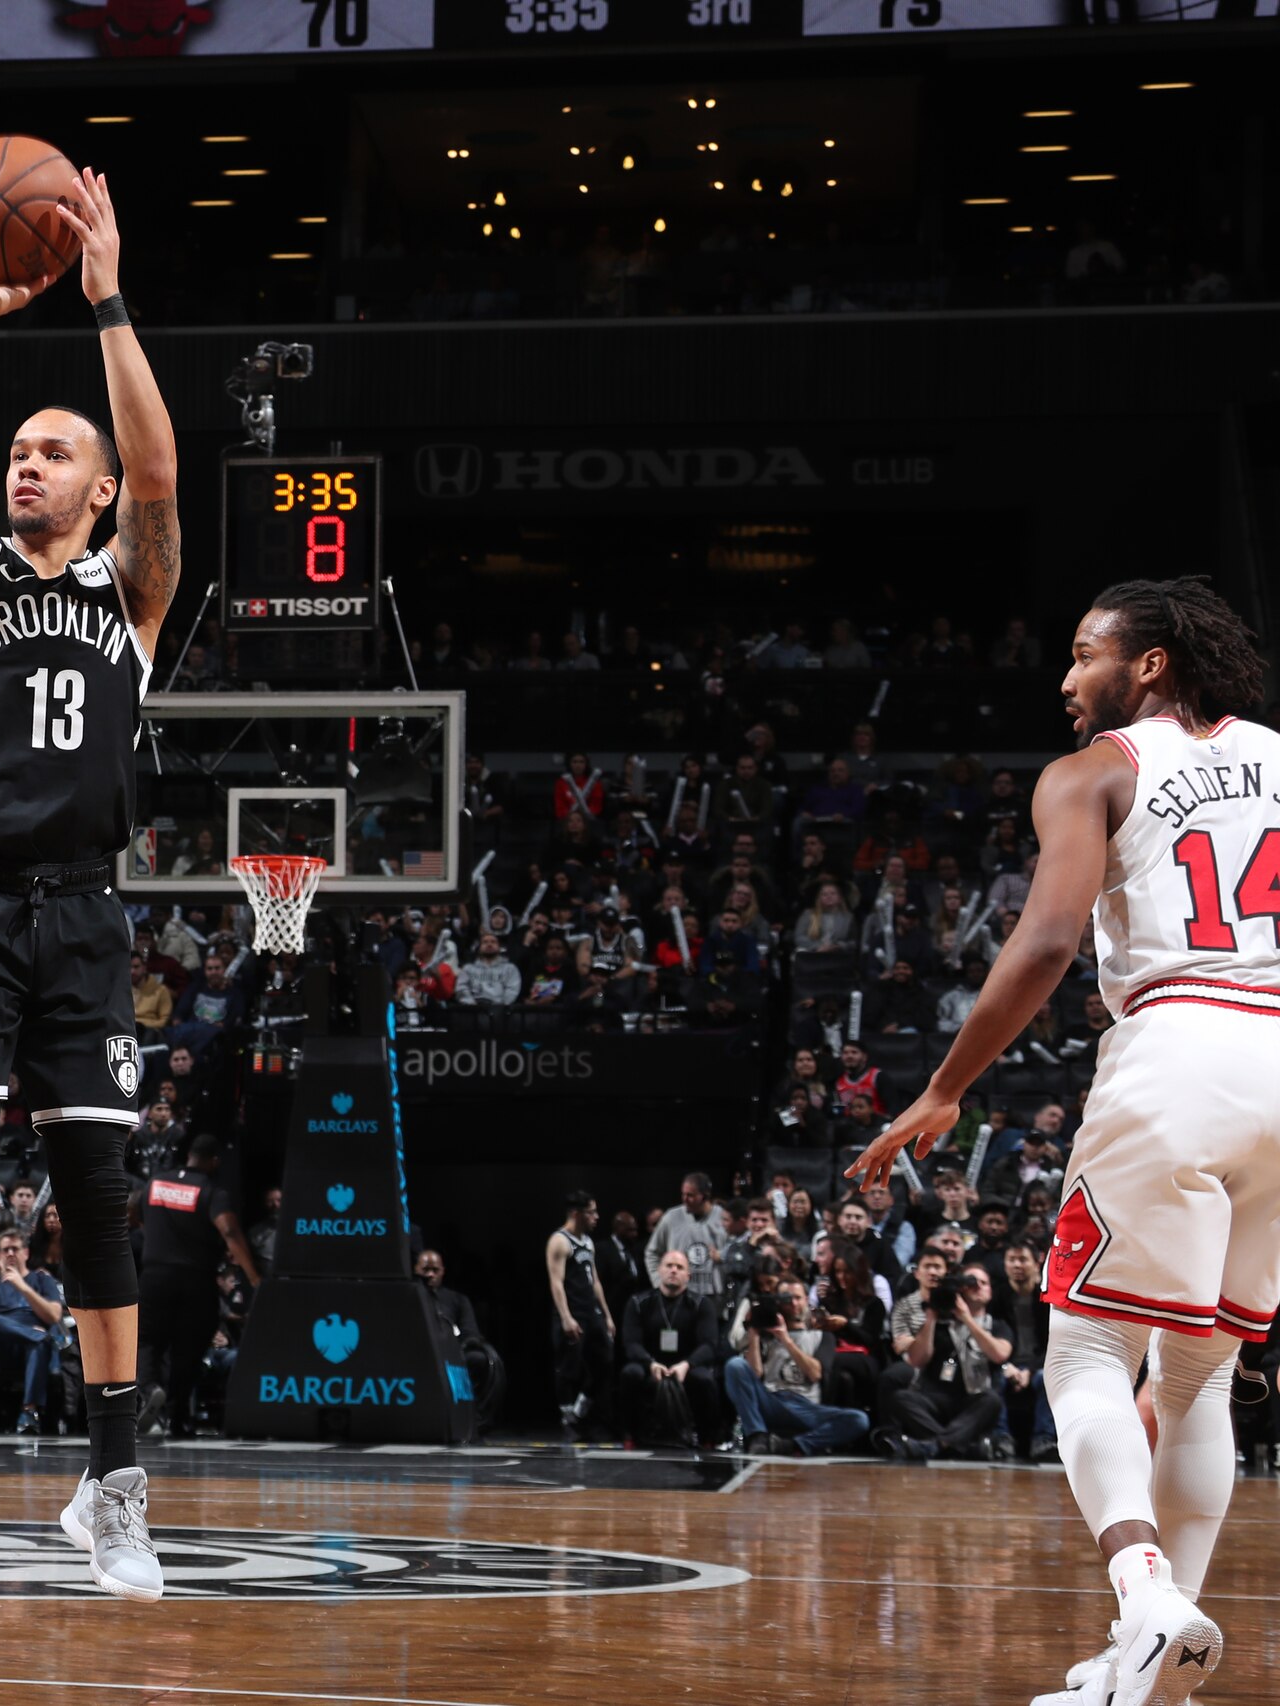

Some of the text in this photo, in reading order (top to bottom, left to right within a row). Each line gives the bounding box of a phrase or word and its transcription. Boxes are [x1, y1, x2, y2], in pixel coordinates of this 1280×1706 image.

[493, 447, 935, 490] HONDA CLUB
[273, 472, 358, 512] 3:35
[306, 515, 346, 583] 8
[269, 597, 369, 617] TISSOT
[25, 667, 86, 751] 13
[1146, 762, 1262, 829] SELDEN
[1172, 827, 1280, 953] 14
[307, 1119, 379, 1134] BARCLAYS
[295, 1218, 388, 1236] BARCLAYS
[259, 1375, 416, 1406] BARCLAYS
